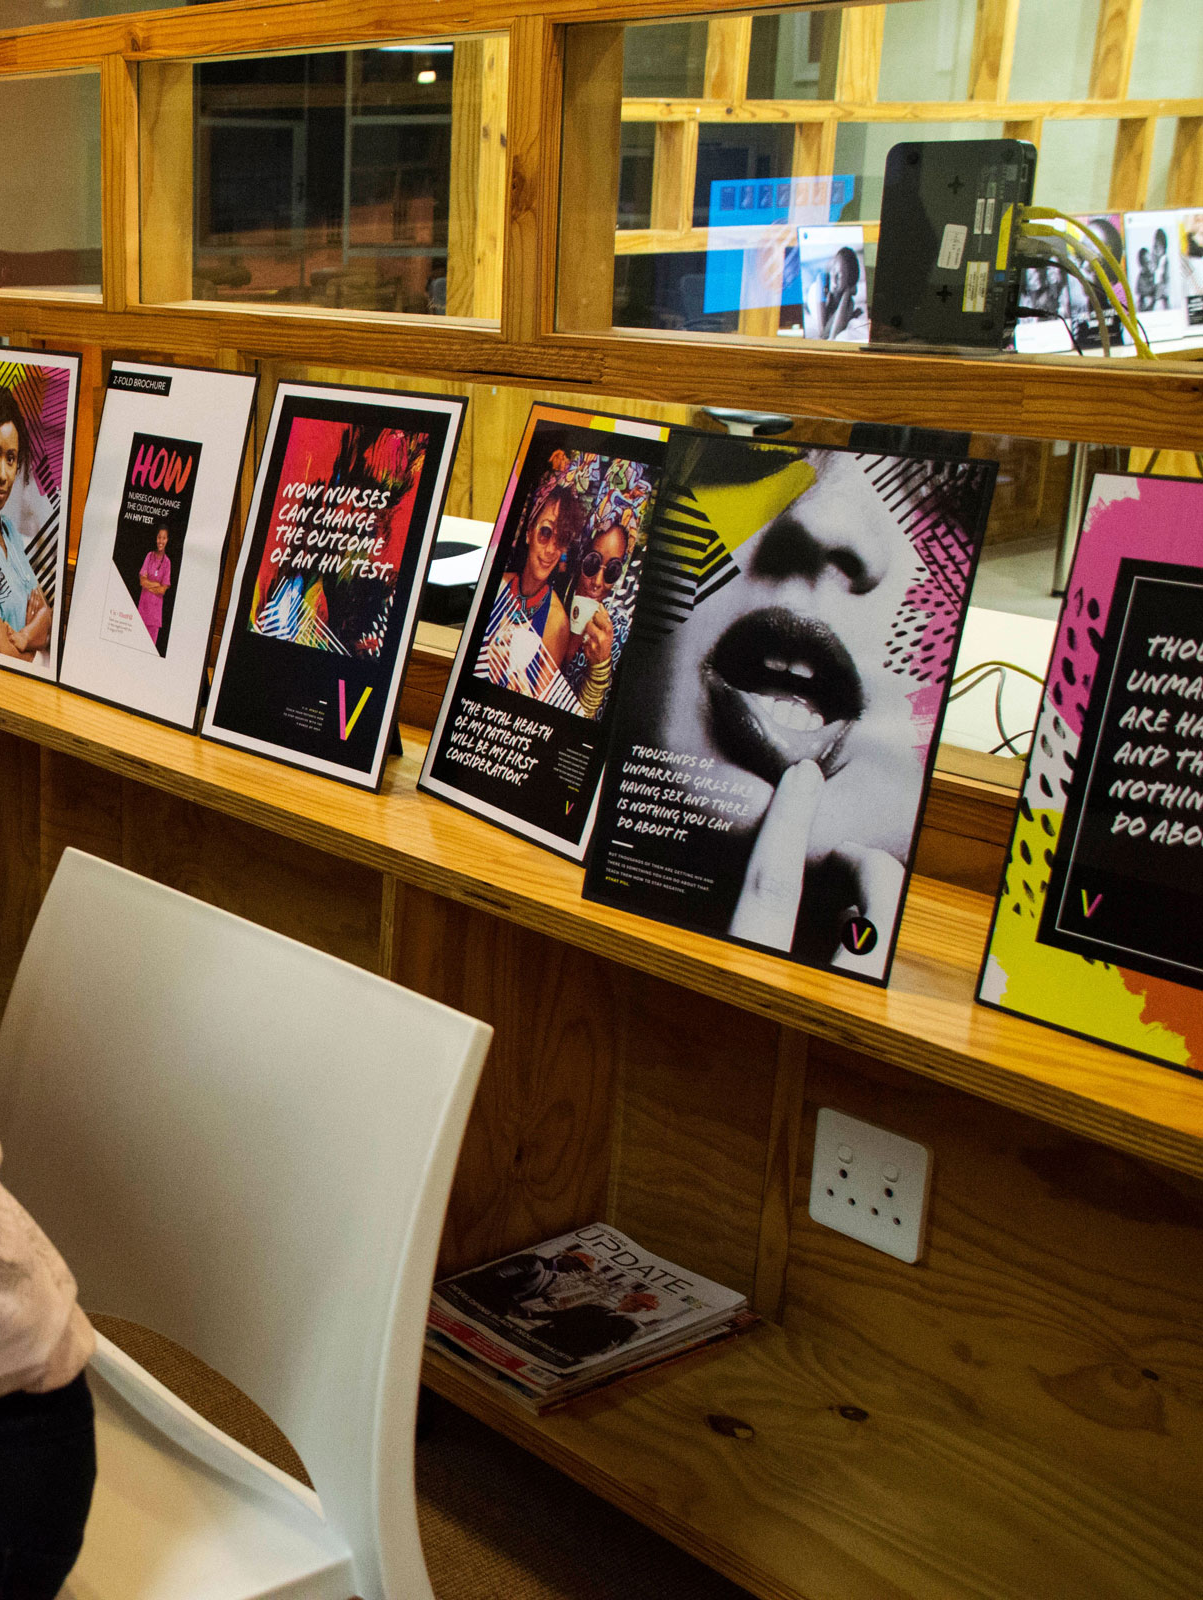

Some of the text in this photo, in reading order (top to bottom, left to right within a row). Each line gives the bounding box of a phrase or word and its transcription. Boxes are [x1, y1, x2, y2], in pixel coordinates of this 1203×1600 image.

[113, 376, 167, 390] Z-FOLD BROCHURE
[131, 443, 193, 494] HOW
[127, 501, 170, 517] THE OUTCOME OF
[128, 491, 181, 510] NURSES CAN CHANGE
[282, 482, 391, 510] NOW NURSES
[124, 512, 154, 525] AN HIV TEST.
[278, 503, 377, 535] CAN CHANGE
[275, 524, 385, 556] THE OUTCOME
[270, 547, 394, 582] OF AN HIV TEST.
[1126, 668, 1203, 701] UNMA
[338, 678, 373, 741] V
[482, 706, 513, 726] TOTAL
[512, 716, 554, 742] HEALTH
[1118, 705, 1171, 733] ARE
[454, 715, 532, 751] OF MY PATIENTS
[450, 730, 475, 748] WILL
[475, 738, 490, 754] BE
[488, 744, 508, 763] MY
[504, 749, 539, 771] FIRST
[631, 744, 715, 772] THOUSANDS OF
[1113, 741, 1171, 768] AND
[622, 762, 755, 798] UNMARRIED GIRLS ARE
[617, 797, 734, 832] IS NOTHING YOU CAN
[619, 780, 750, 816] HAVING SEX AND THERE
[617, 816, 689, 842] DO ABOUT IT.
[1110, 810, 1203, 848] DO ABO
[575, 1227, 694, 1295] UPDATE
